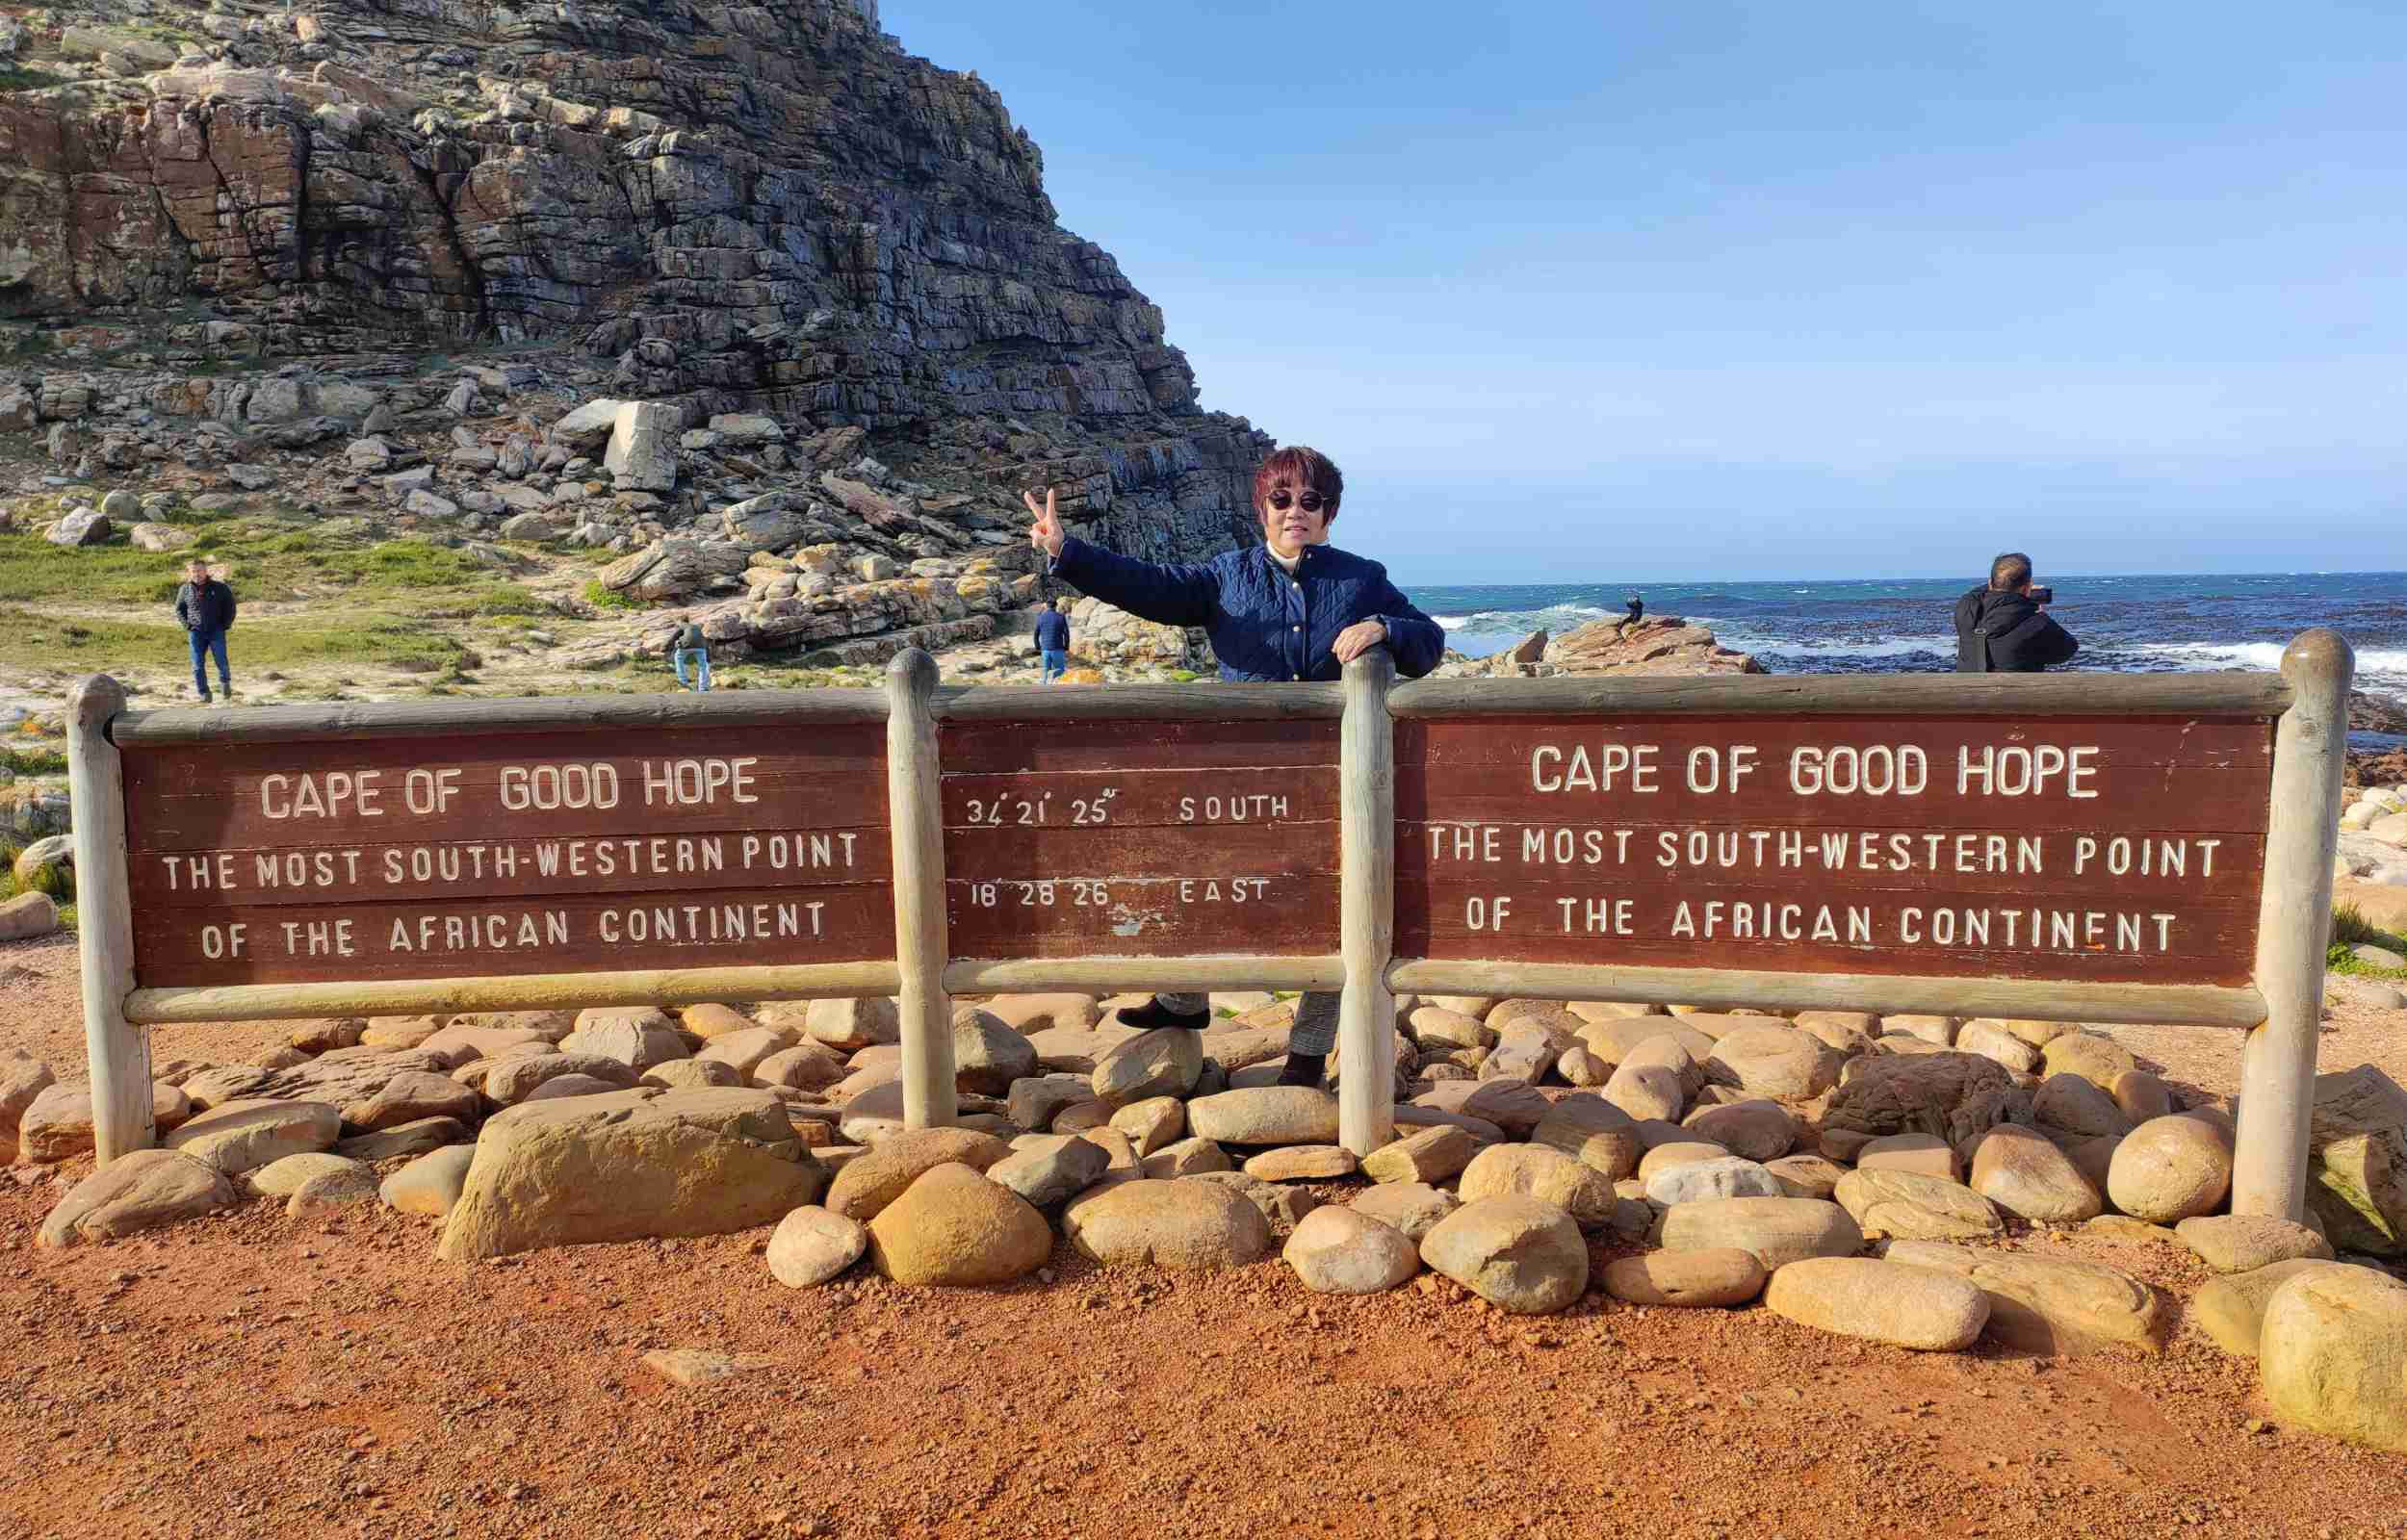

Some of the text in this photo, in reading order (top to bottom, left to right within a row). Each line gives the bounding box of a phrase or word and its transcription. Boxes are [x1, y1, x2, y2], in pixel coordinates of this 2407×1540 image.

[260, 757, 759, 819] CAPE OF GOOD HOPE
[1533, 745, 2100, 799] CAPE OF GOOD HOPE
[1178, 795, 1288, 822] SOUTH
[162, 832, 859, 890] THE MOST SOUTH-WESTERN POINT
[1430, 826, 2221, 878] THE MOST SOUTH-WESTERN POINT
[1180, 879, 1271, 903] EAST
[201, 901, 827, 960] OF THE AFRICAN CONTINENT
[1465, 897, 2178, 952] OF THE AFRICAN CONTINENT
